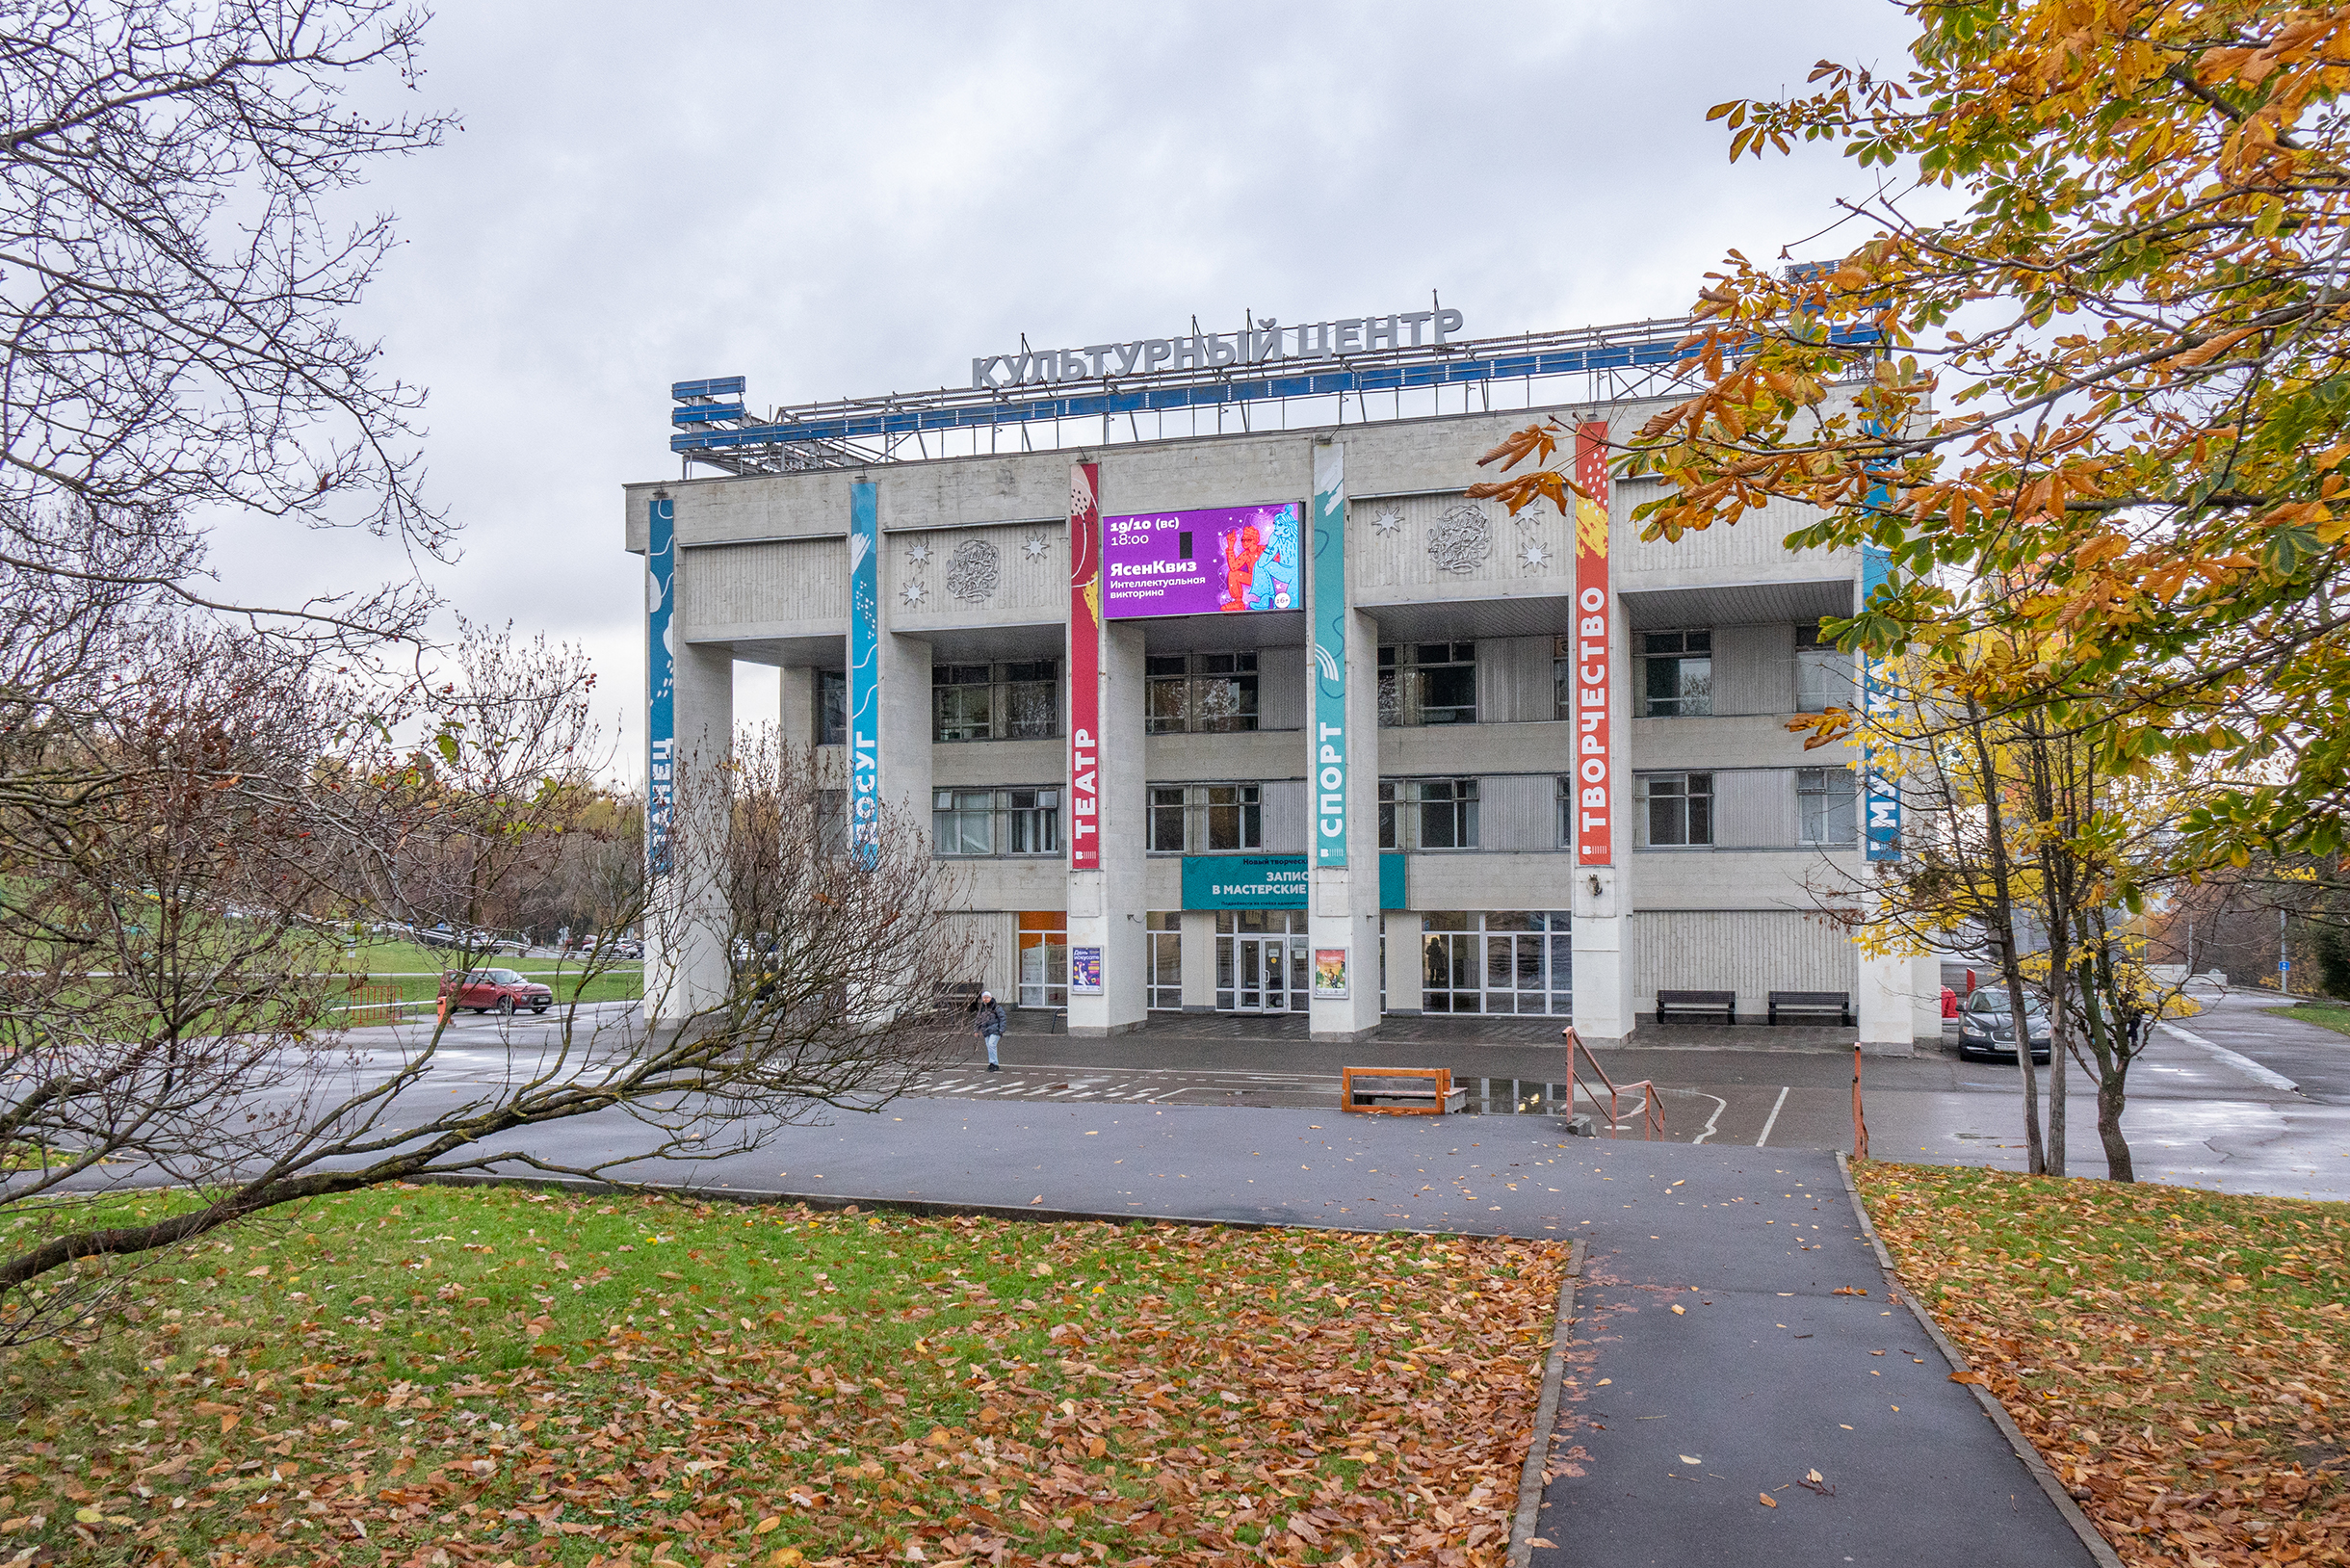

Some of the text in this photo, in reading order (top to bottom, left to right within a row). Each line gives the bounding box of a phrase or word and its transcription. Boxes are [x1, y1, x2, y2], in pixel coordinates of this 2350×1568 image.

[971, 308, 1464, 389] КУЛЬТУРНЫЙ ЦЕНТР
[1110, 517, 1180, 533] 19/10 (вс)
[1110, 533, 1149, 546] 18:00
[1110, 561, 1197, 577] ЯсенКвиз
[1110, 576, 1206, 589] Интеллектуальная
[1110, 588, 1164, 599] викторина
[1580, 587, 1606, 832] ТВОРЧЕСТВО
[1868, 662, 1896, 827] МУКА
[1075, 728, 1096, 839] ТЕАТР
[1319, 722, 1343, 838] СПОРТ
[1212, 884, 1307, 895] В МАСТЕРСКИЕ
